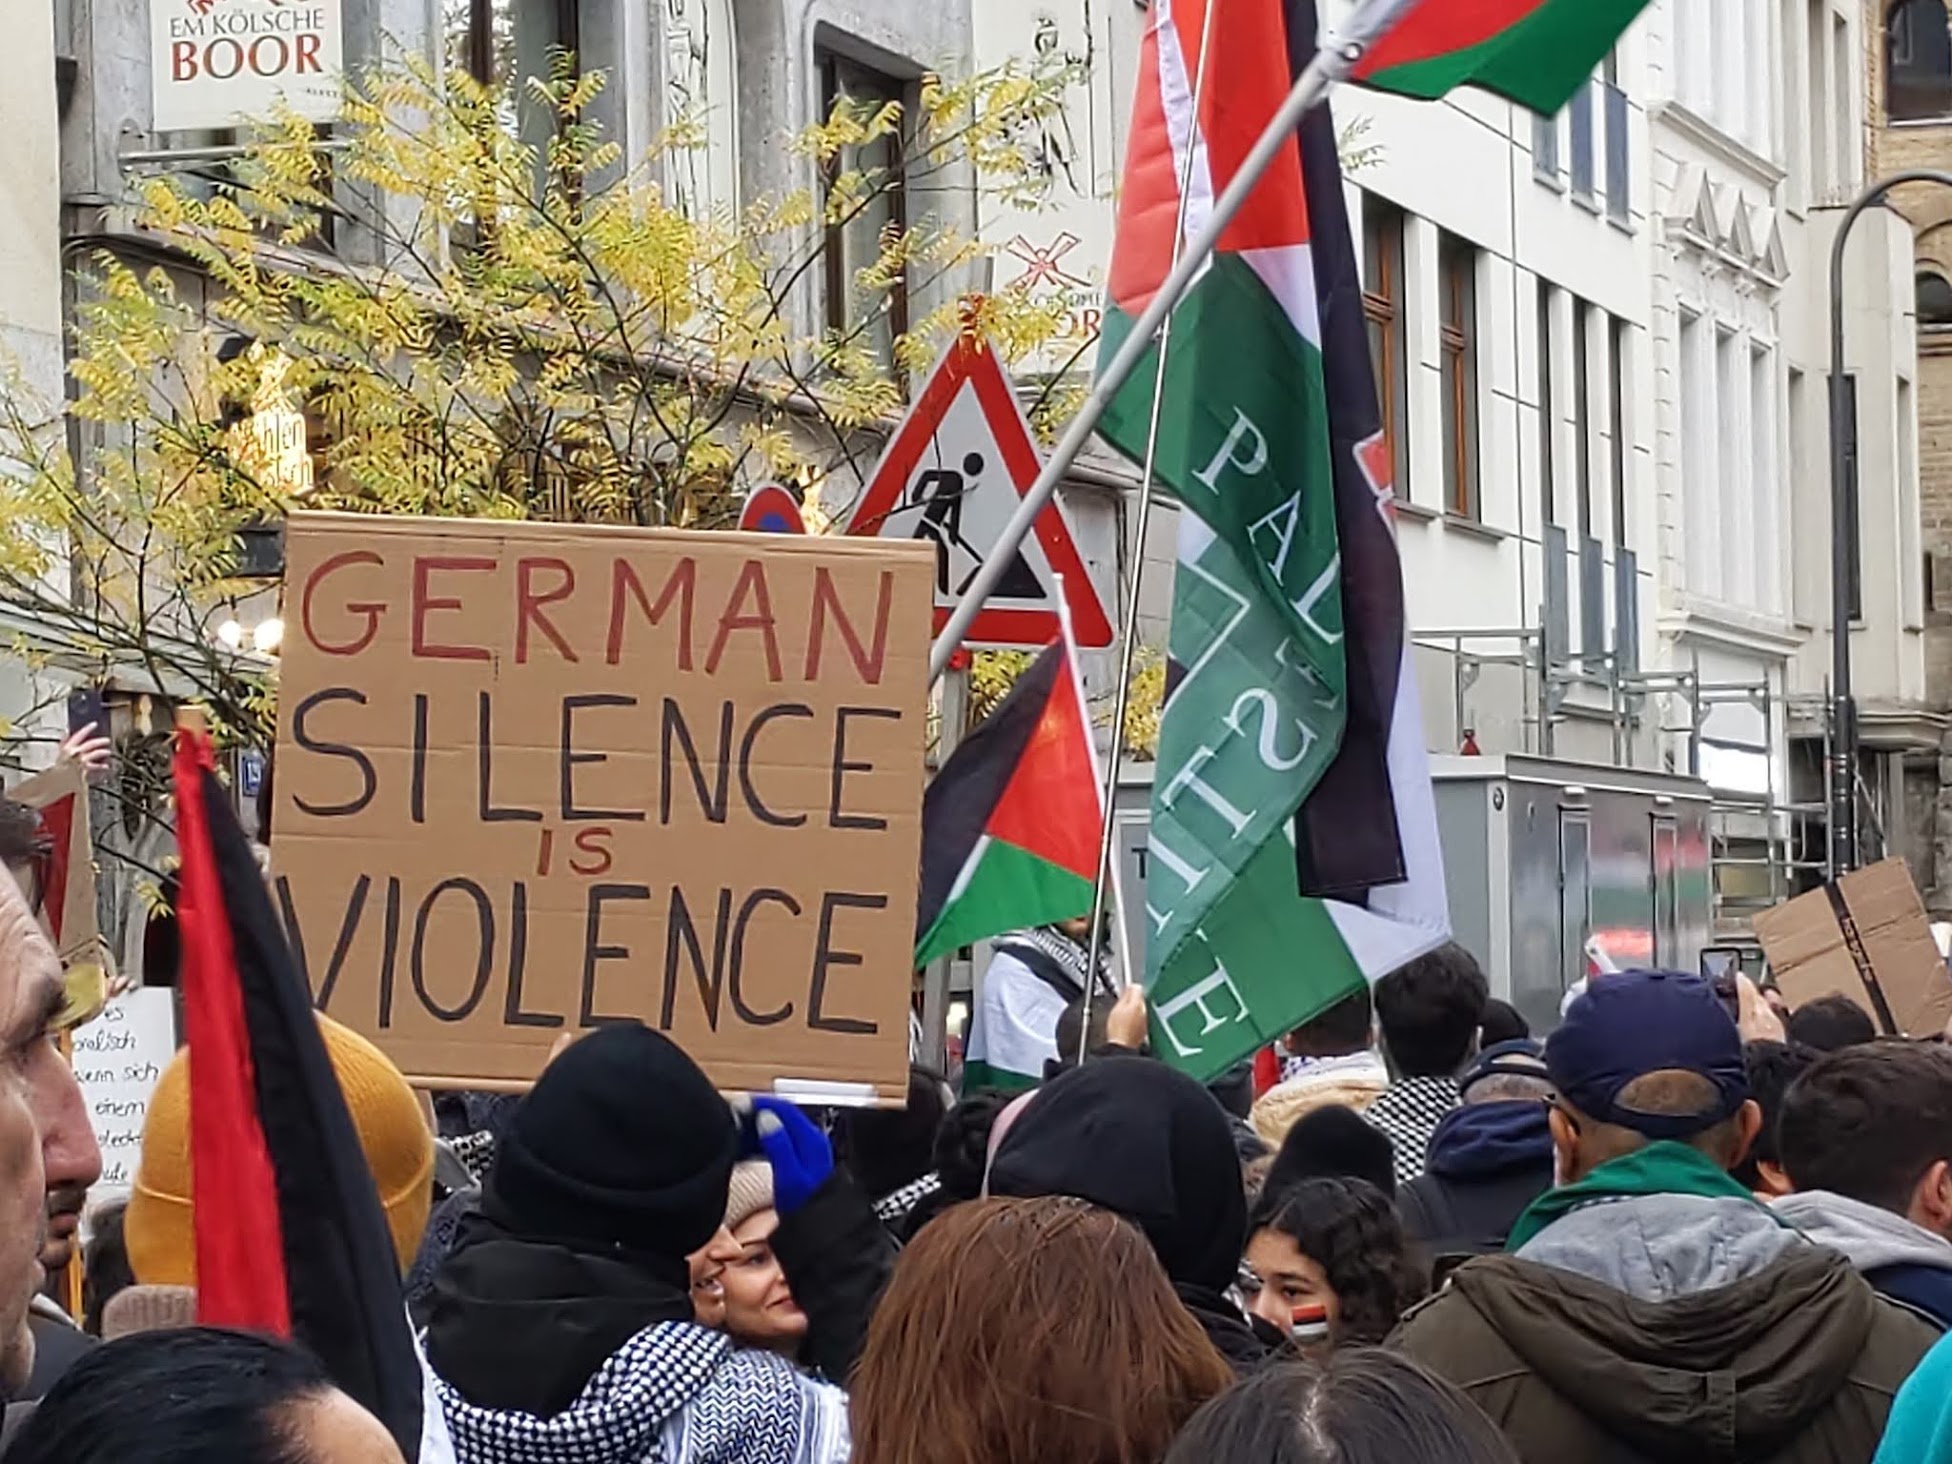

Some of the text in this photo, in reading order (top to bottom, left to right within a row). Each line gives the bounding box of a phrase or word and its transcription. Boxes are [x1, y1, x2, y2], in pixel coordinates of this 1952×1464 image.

[170, 7, 325, 38] EM KÖLSCHE
[172, 33, 324, 82] BOOR
[301, 549, 894, 686] GERMAN
[291, 687, 902, 831] SILENCE
[536, 826, 614, 876] IS
[275, 873, 889, 1034] VIOLENCE
